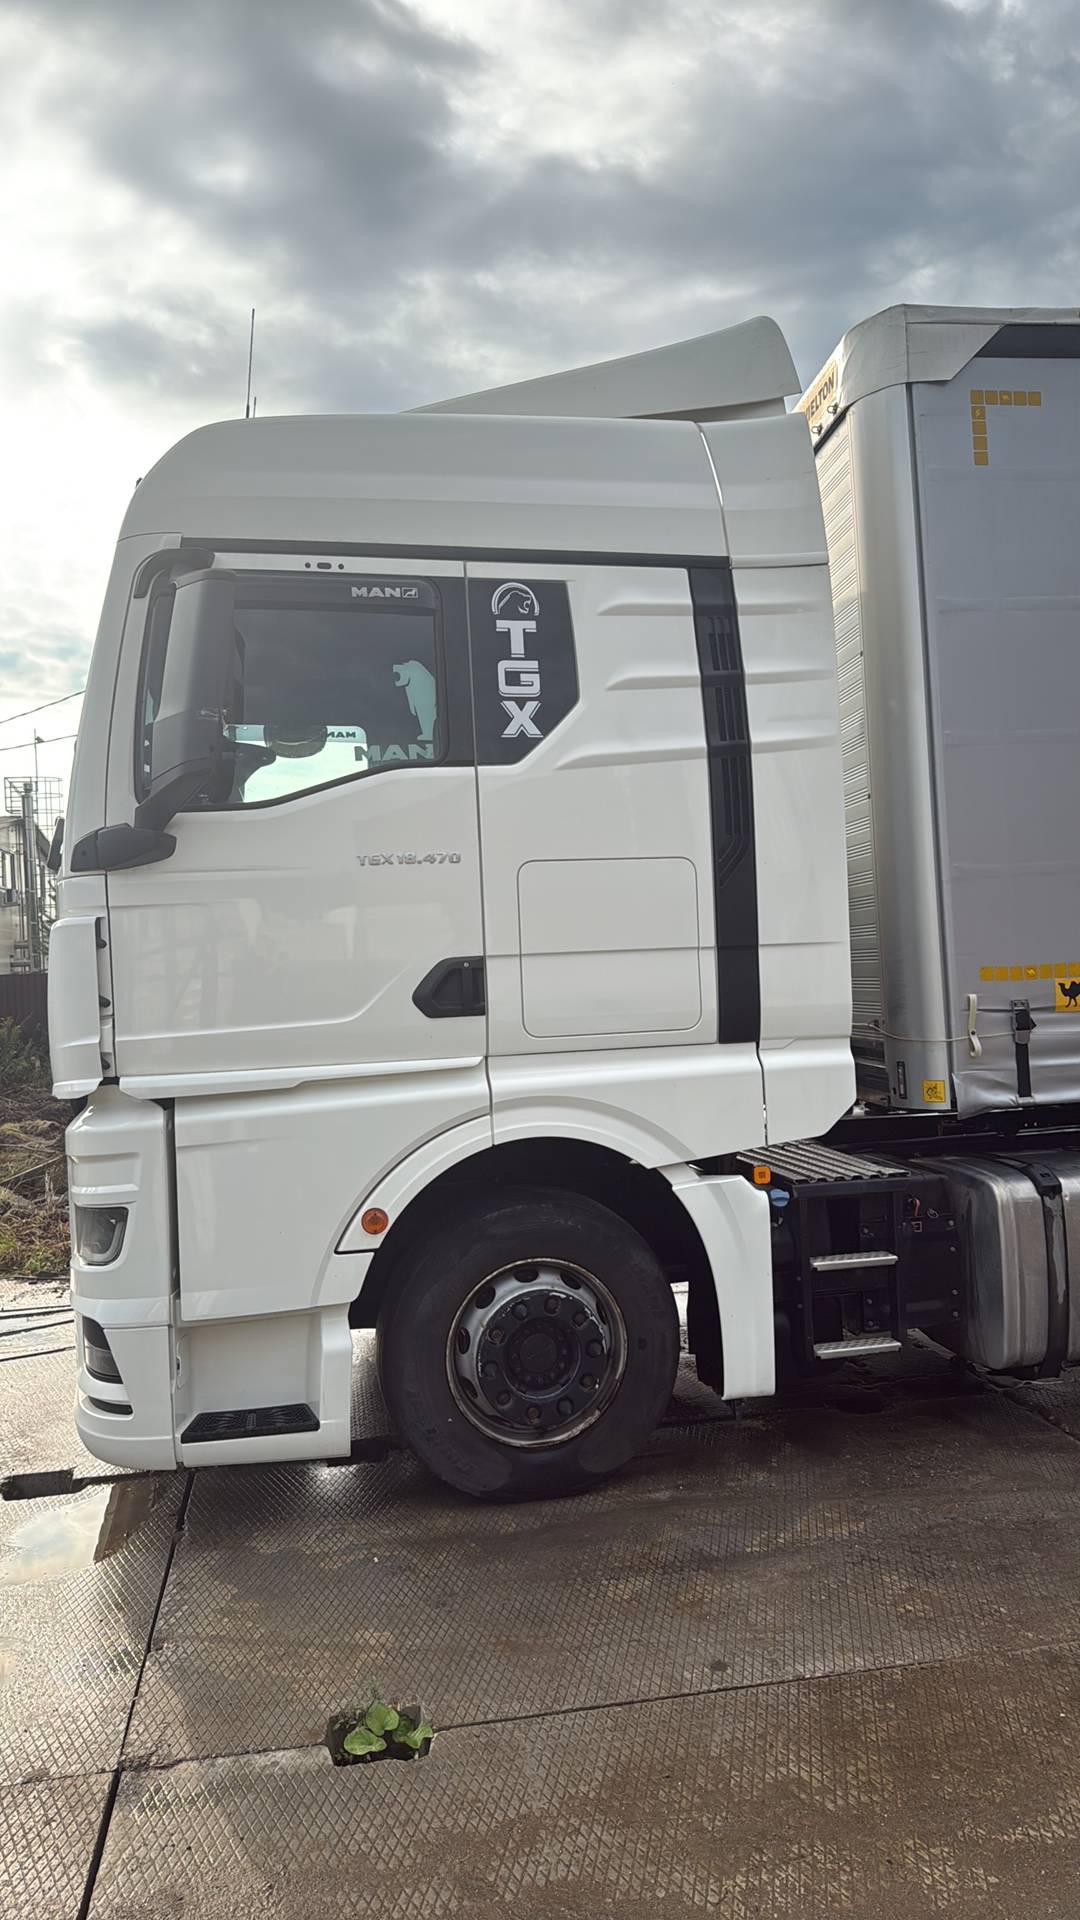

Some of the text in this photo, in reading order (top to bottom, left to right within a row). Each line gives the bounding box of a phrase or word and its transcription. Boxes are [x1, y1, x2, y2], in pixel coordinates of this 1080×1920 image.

[351, 586, 401, 598] MAN
[495, 619, 544, 738] TGX
[354, 744, 434, 762] MAN
